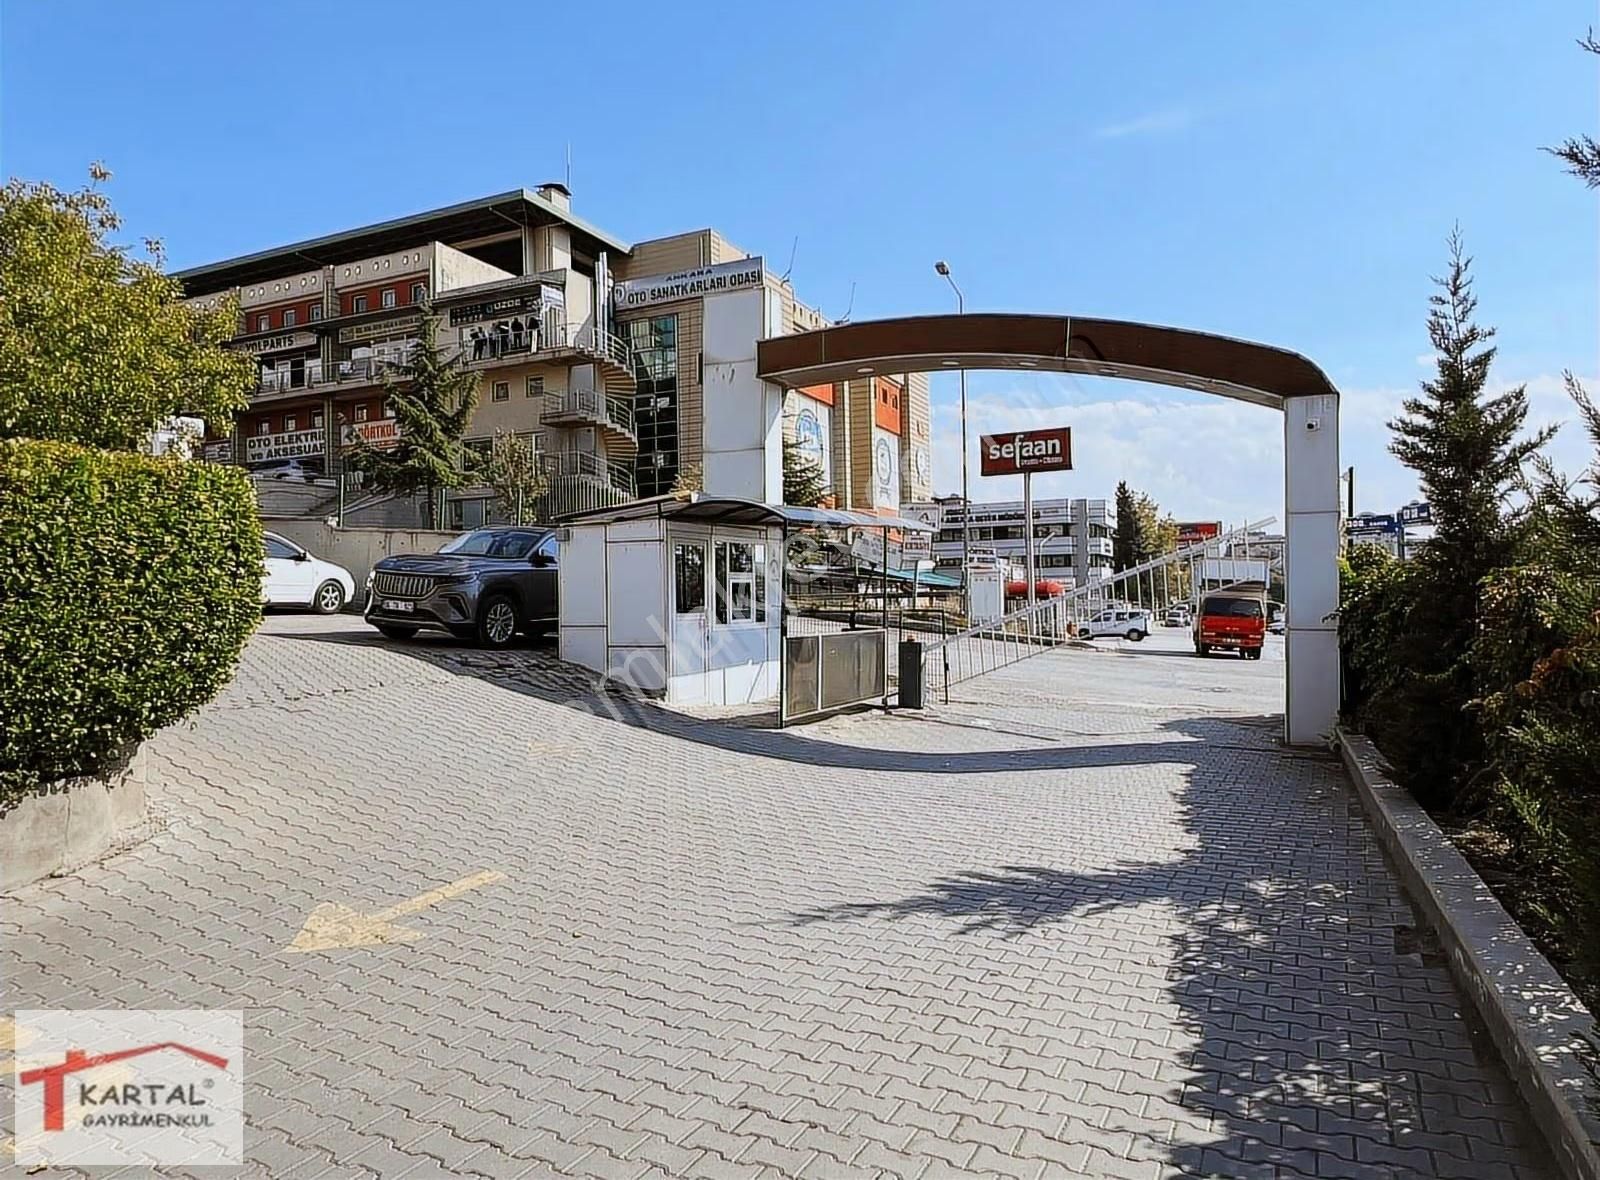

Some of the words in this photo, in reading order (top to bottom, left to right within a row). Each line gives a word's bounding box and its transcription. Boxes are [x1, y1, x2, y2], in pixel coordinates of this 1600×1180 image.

[666, 269, 713, 282] ANKARA
[627, 291, 647, 304] OTO
[248, 437, 271, 449] OTO
[989, 434, 1061, 468] sefaan
